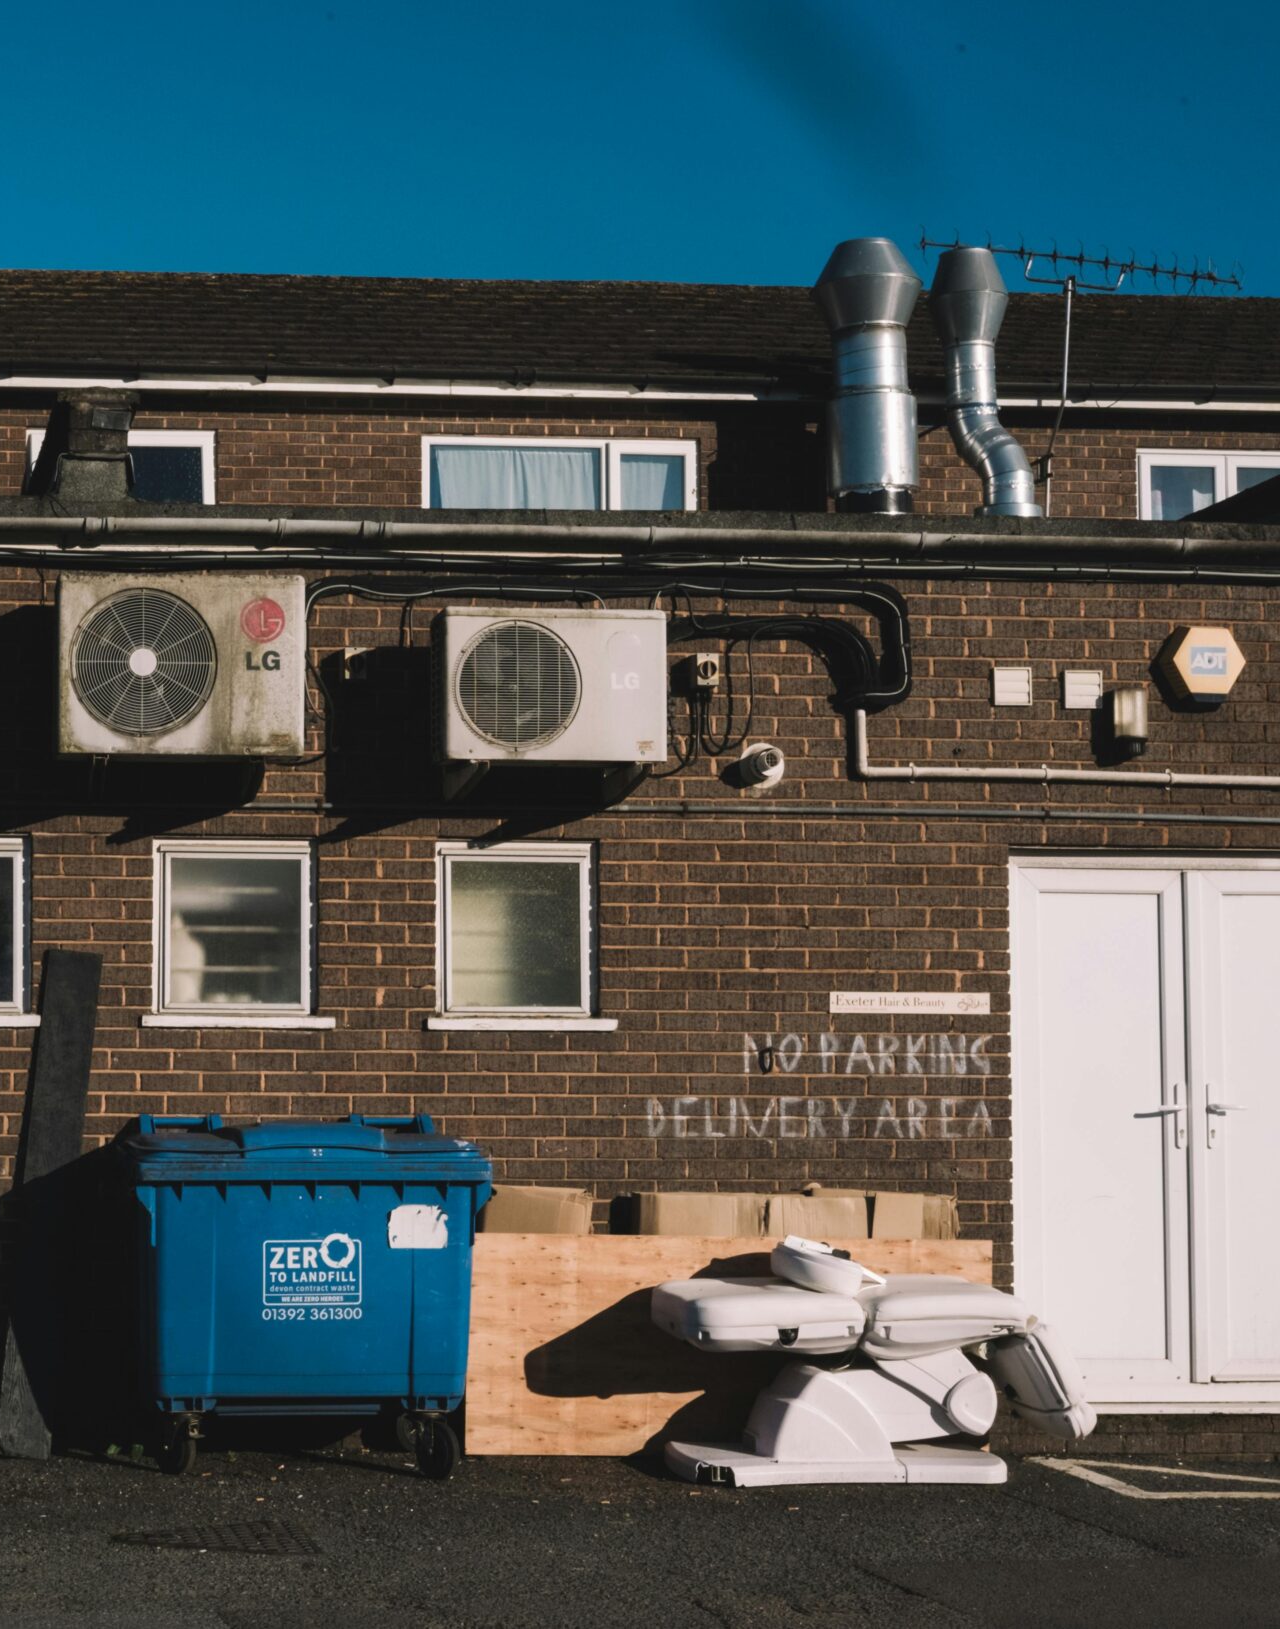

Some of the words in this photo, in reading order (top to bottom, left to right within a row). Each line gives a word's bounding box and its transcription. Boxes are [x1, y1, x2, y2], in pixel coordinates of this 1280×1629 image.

[245, 650, 281, 672] LG
[1191, 651, 1227, 670] ADT
[610, 671, 640, 690] LG
[835, 994, 877, 1007] Exeter
[878, 996, 899, 1007] Hair
[902, 998, 910, 1007] &
[913, 997, 946, 1008] Beauty
[743, 1033, 803, 1074] NO
[820, 1033, 993, 1075] PARKING
[646, 1097, 858, 1139] DELIVERY
[874, 1098, 993, 1139] AREA
[269, 1232, 356, 1269] ZERO
[269, 1271, 287, 1283] TO
[291, 1271, 357, 1283] LANDFILL
[331, 1284, 355, 1292] waste
[262, 1308, 306, 1321] 01392
[310, 1308, 363, 1320] 361300
